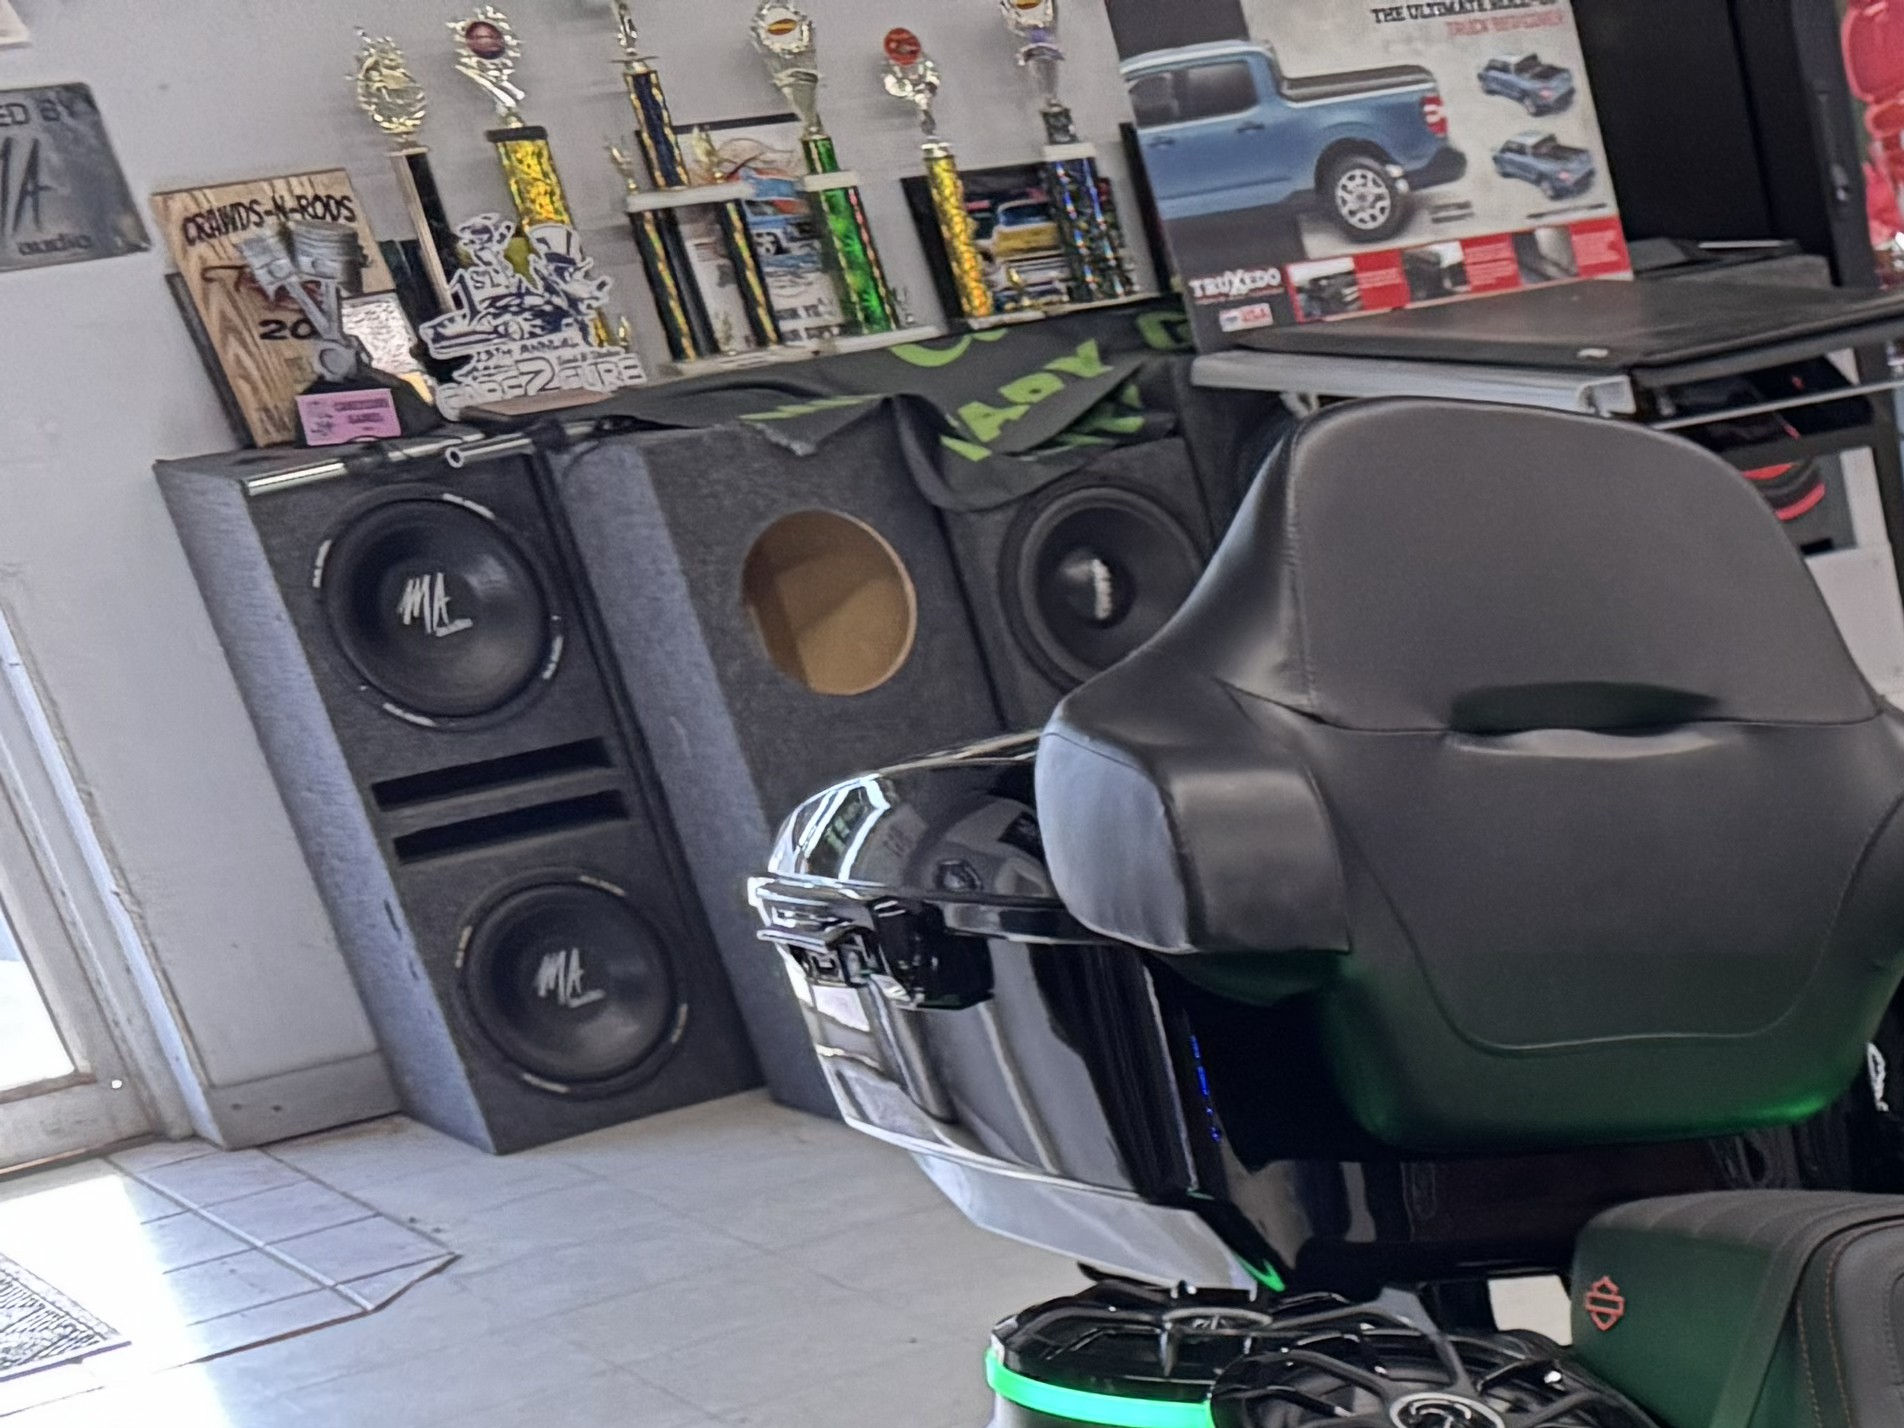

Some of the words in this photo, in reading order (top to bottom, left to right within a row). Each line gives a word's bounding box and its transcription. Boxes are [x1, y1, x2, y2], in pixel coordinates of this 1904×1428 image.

[1371, 7, 1406, 23] THE
[399, 571, 472, 637] MA
[537, 947, 604, 1009] MA
